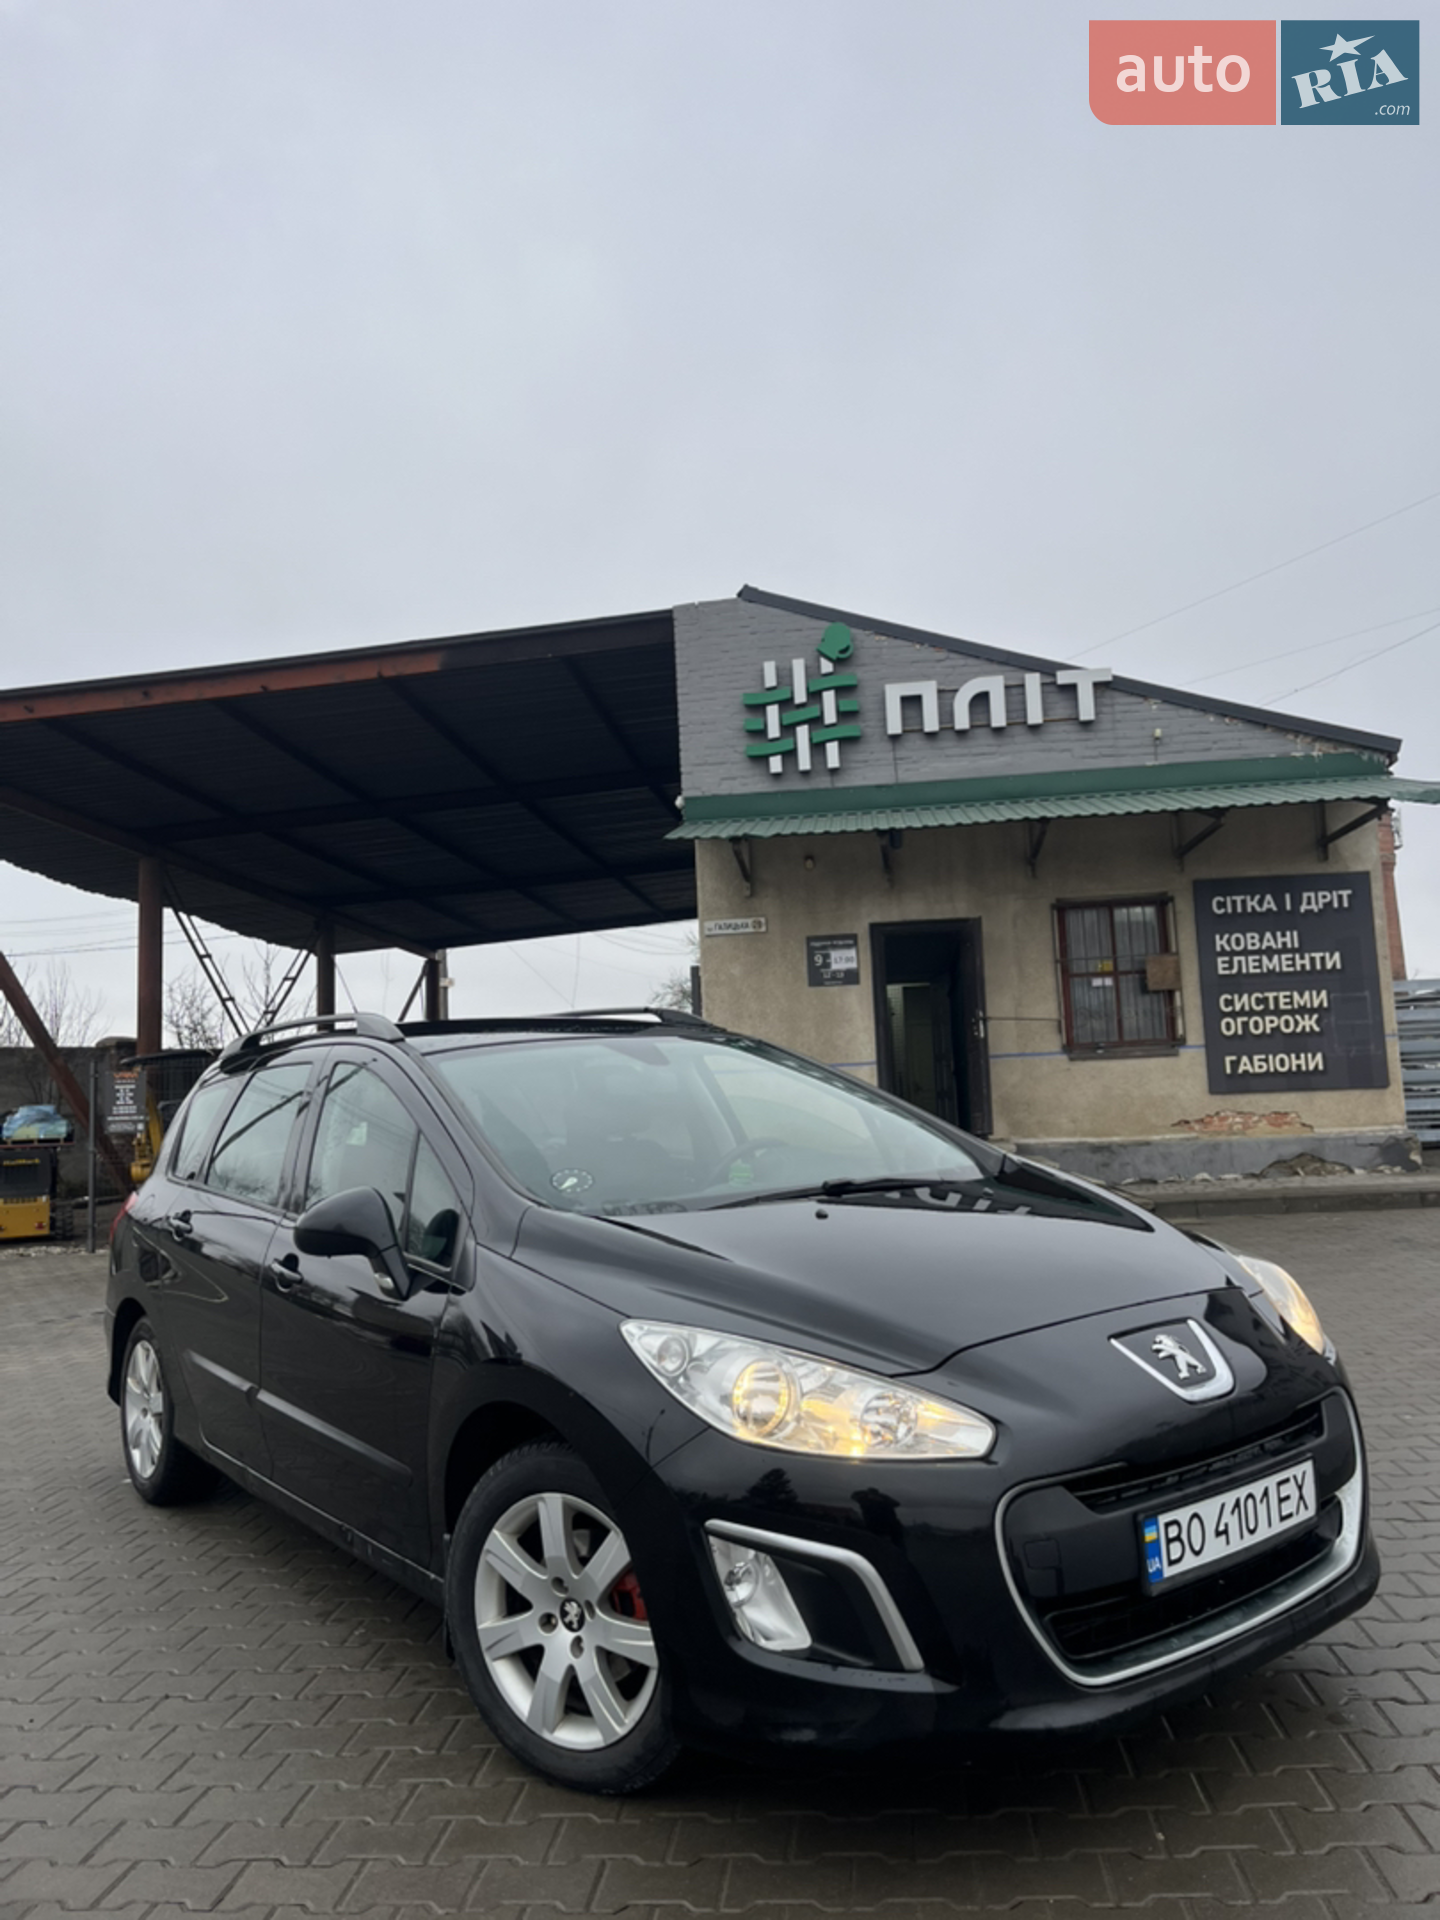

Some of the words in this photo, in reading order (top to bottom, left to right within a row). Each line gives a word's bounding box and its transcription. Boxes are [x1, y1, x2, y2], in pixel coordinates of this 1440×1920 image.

[884, 667, 1113, 735] ПЛІТ
[1211, 893, 1278, 915] СІТКА
[1284, 892, 1292, 912] І
[1299, 889, 1352, 914] ДРІТ
[1214, 930, 1300, 952] КОВАНІ
[1216, 951, 1342, 975] ЕЛЕМЕНТИ
[1218, 989, 1329, 1013] СИСТЕМИ
[1220, 1013, 1321, 1036] ОГОРОЖ
[1224, 1052, 1324, 1075] ГАБІОНИ
[1163, 1512, 1206, 1567] BO
[1146, 1556, 1162, 1573] UA
